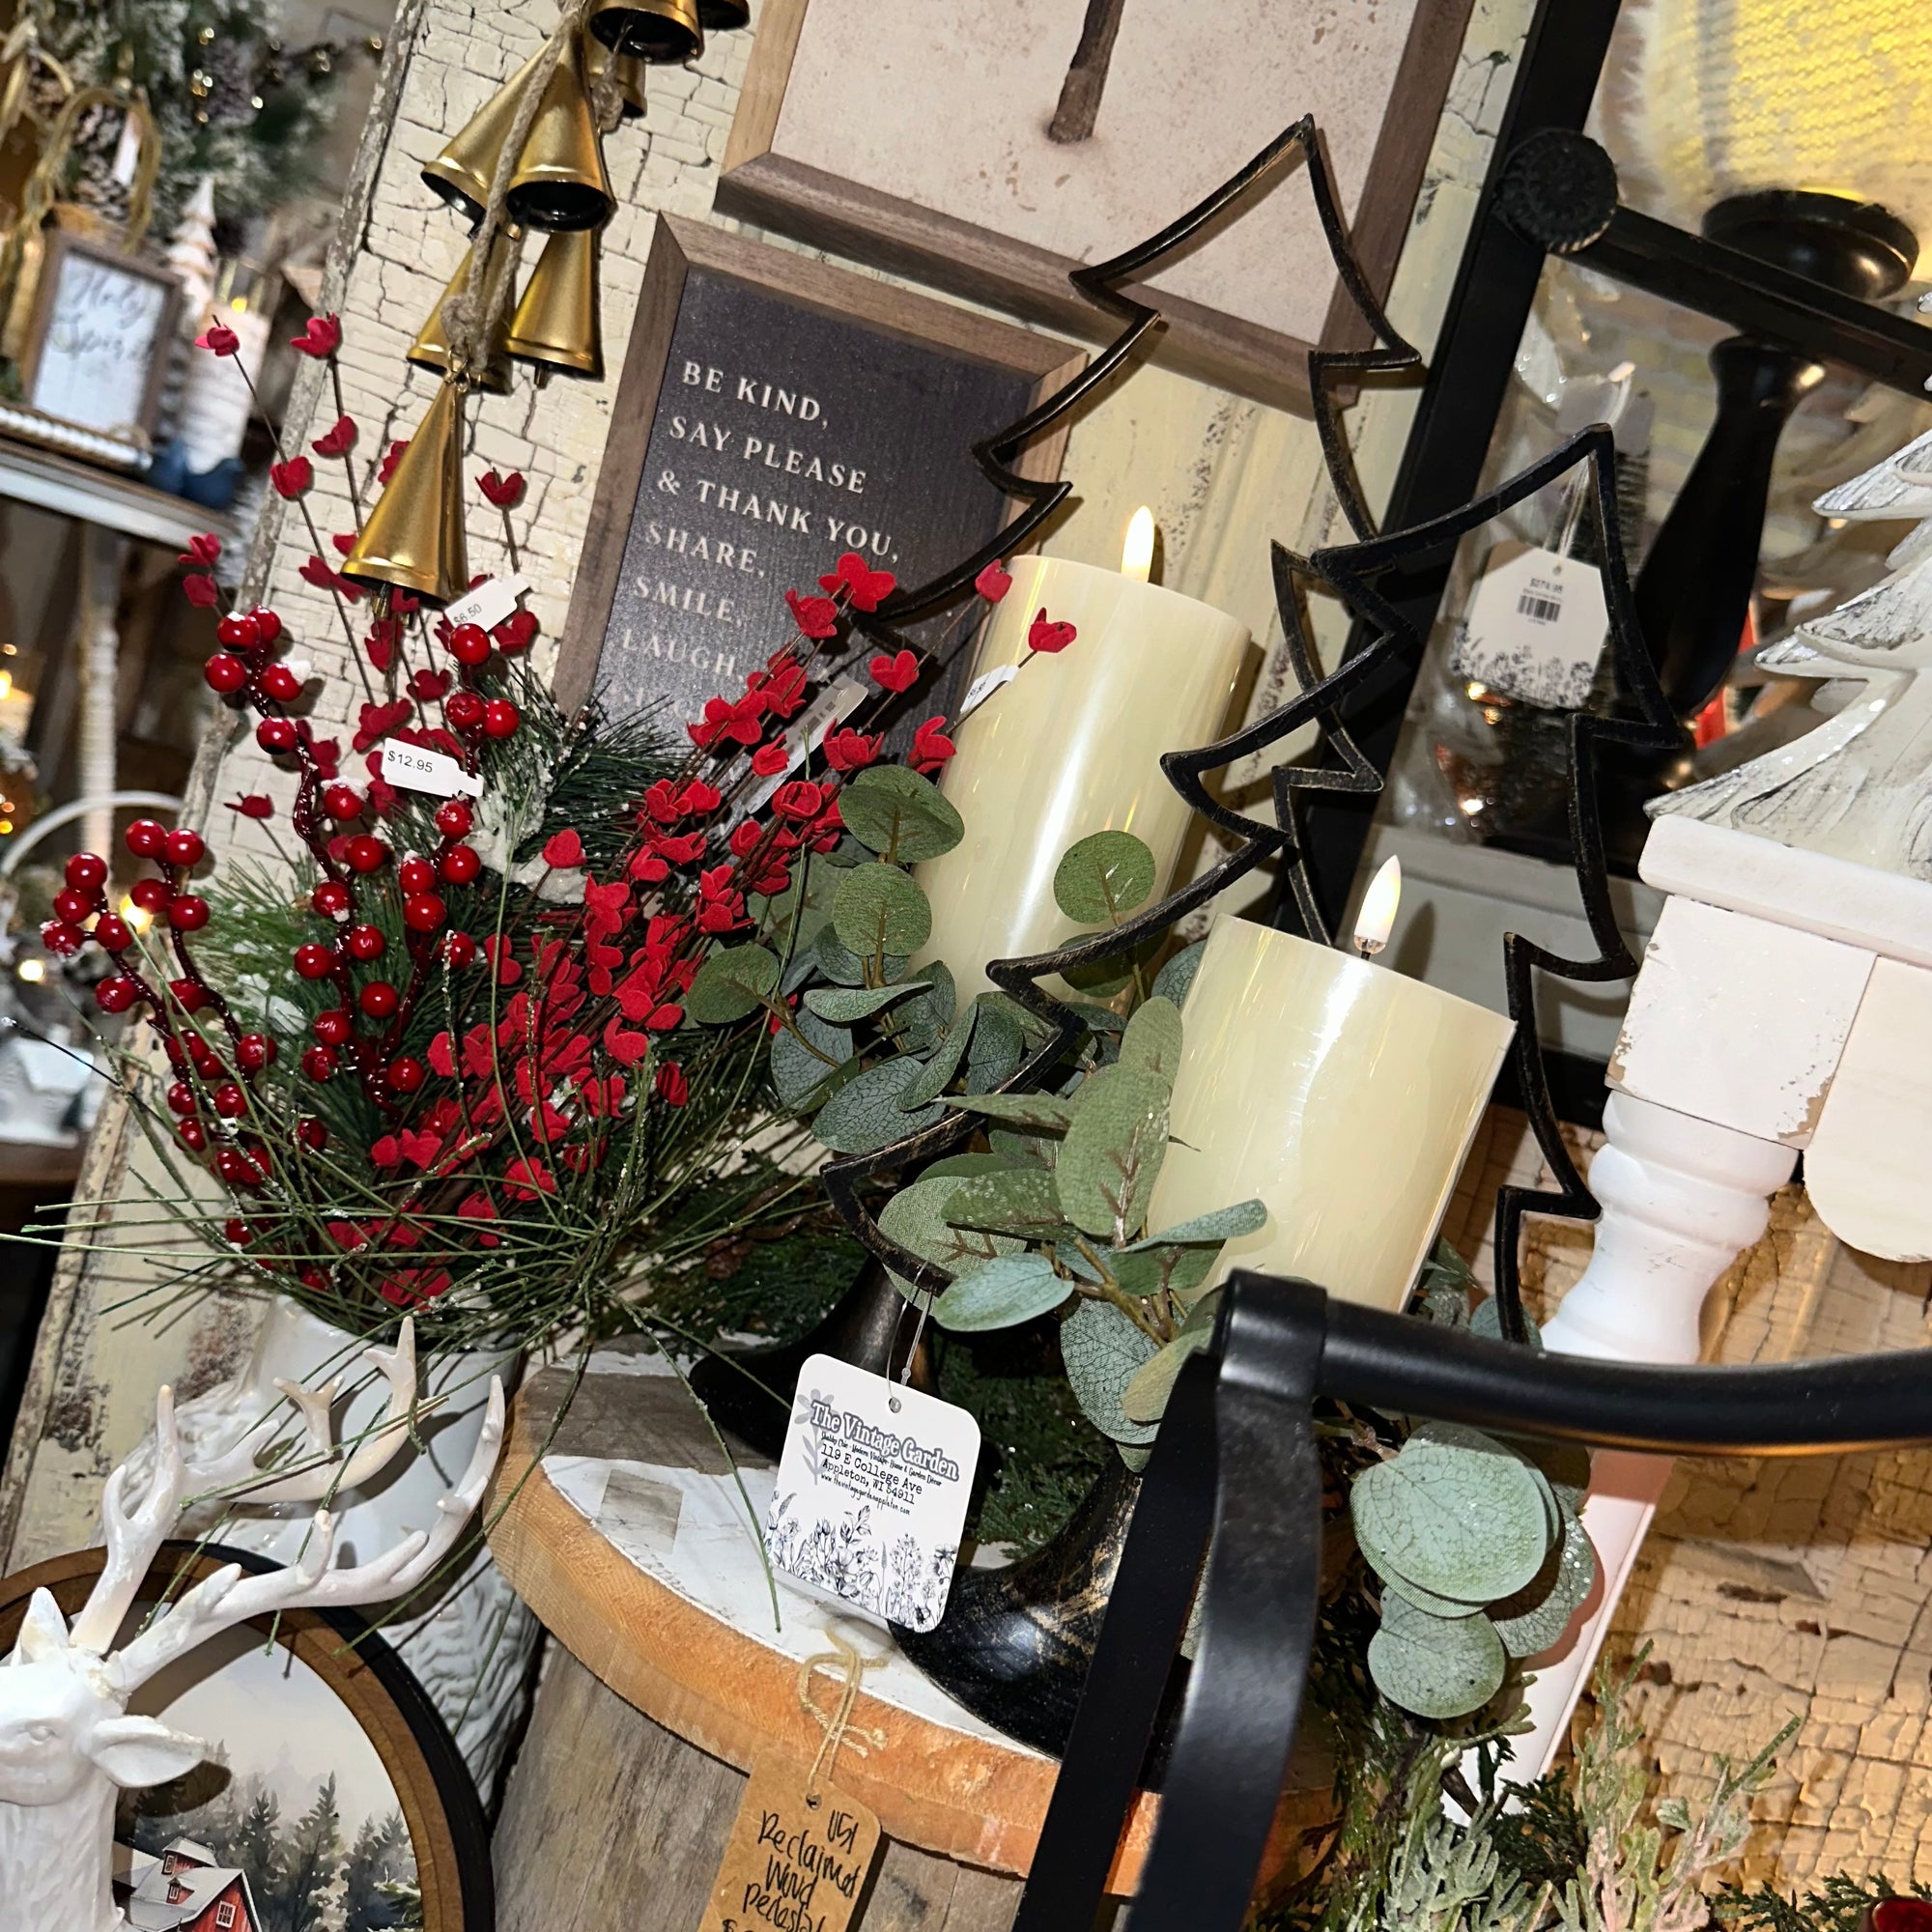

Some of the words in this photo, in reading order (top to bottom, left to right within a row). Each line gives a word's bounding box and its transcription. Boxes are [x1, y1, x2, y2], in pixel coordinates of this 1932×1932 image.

[682, 360, 724, 393] BE
[737, 377, 829, 430] KIND,
[669, 416, 732, 452] SAY
[743, 437, 868, 494] PLEASE
[657, 469, 681, 496] &
[696, 479, 811, 534] THANK
[827, 518, 899, 564] YOU,
[645, 523, 765, 579] SHARE,
[634, 576, 742, 628] SMILE,
[387, 751, 434, 773] $12.95
[810, 1401, 841, 1433] The
[843, 1411, 901, 1457] Vintage
[901, 1436, 959, 1482] Garden
[821, 1443, 841, 1460] 119
[843, 1453, 852, 1465] E
[854, 1458, 899, 1486] College
[902, 1477, 923, 1494] Ave
[822, 1458, 869, 1488] Appleton,
[872, 1478, 884, 1492] WI
[886, 1483, 915, 1505] 54911
[765, 1854, 818, 1910] Wood
